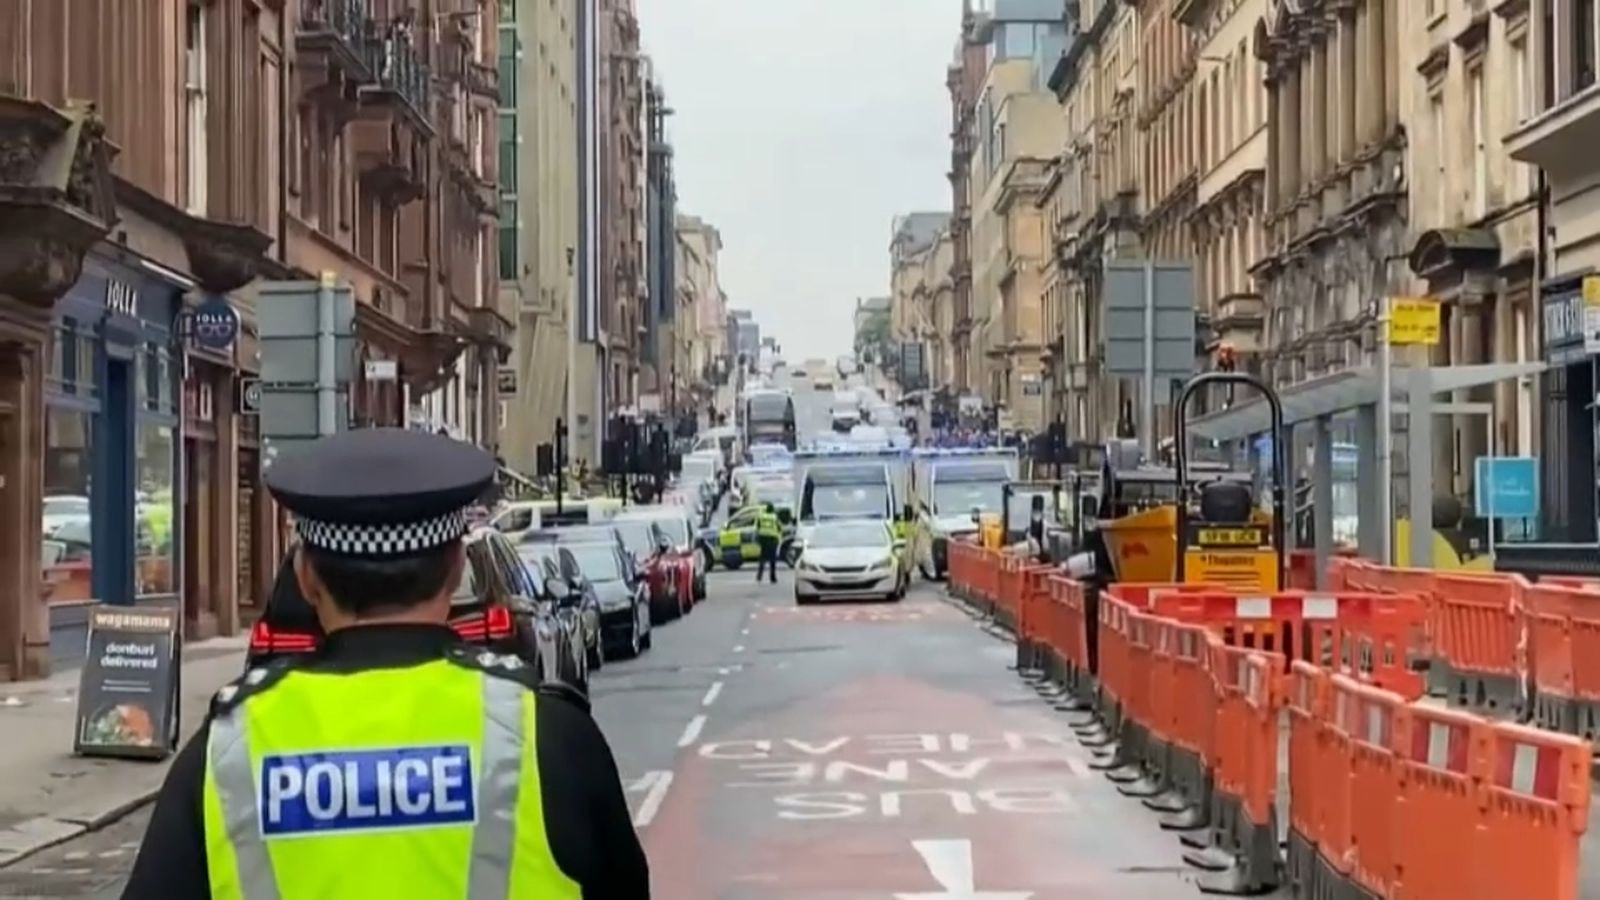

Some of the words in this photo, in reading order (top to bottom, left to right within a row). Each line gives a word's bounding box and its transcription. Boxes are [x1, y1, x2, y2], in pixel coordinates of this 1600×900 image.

[95, 613, 171, 627] wagamama
[105, 642, 155, 656] donburi
[100, 656, 158, 669] delivered
[268, 755, 466, 823] POLICE
[773, 788, 1072, 819] BUS
